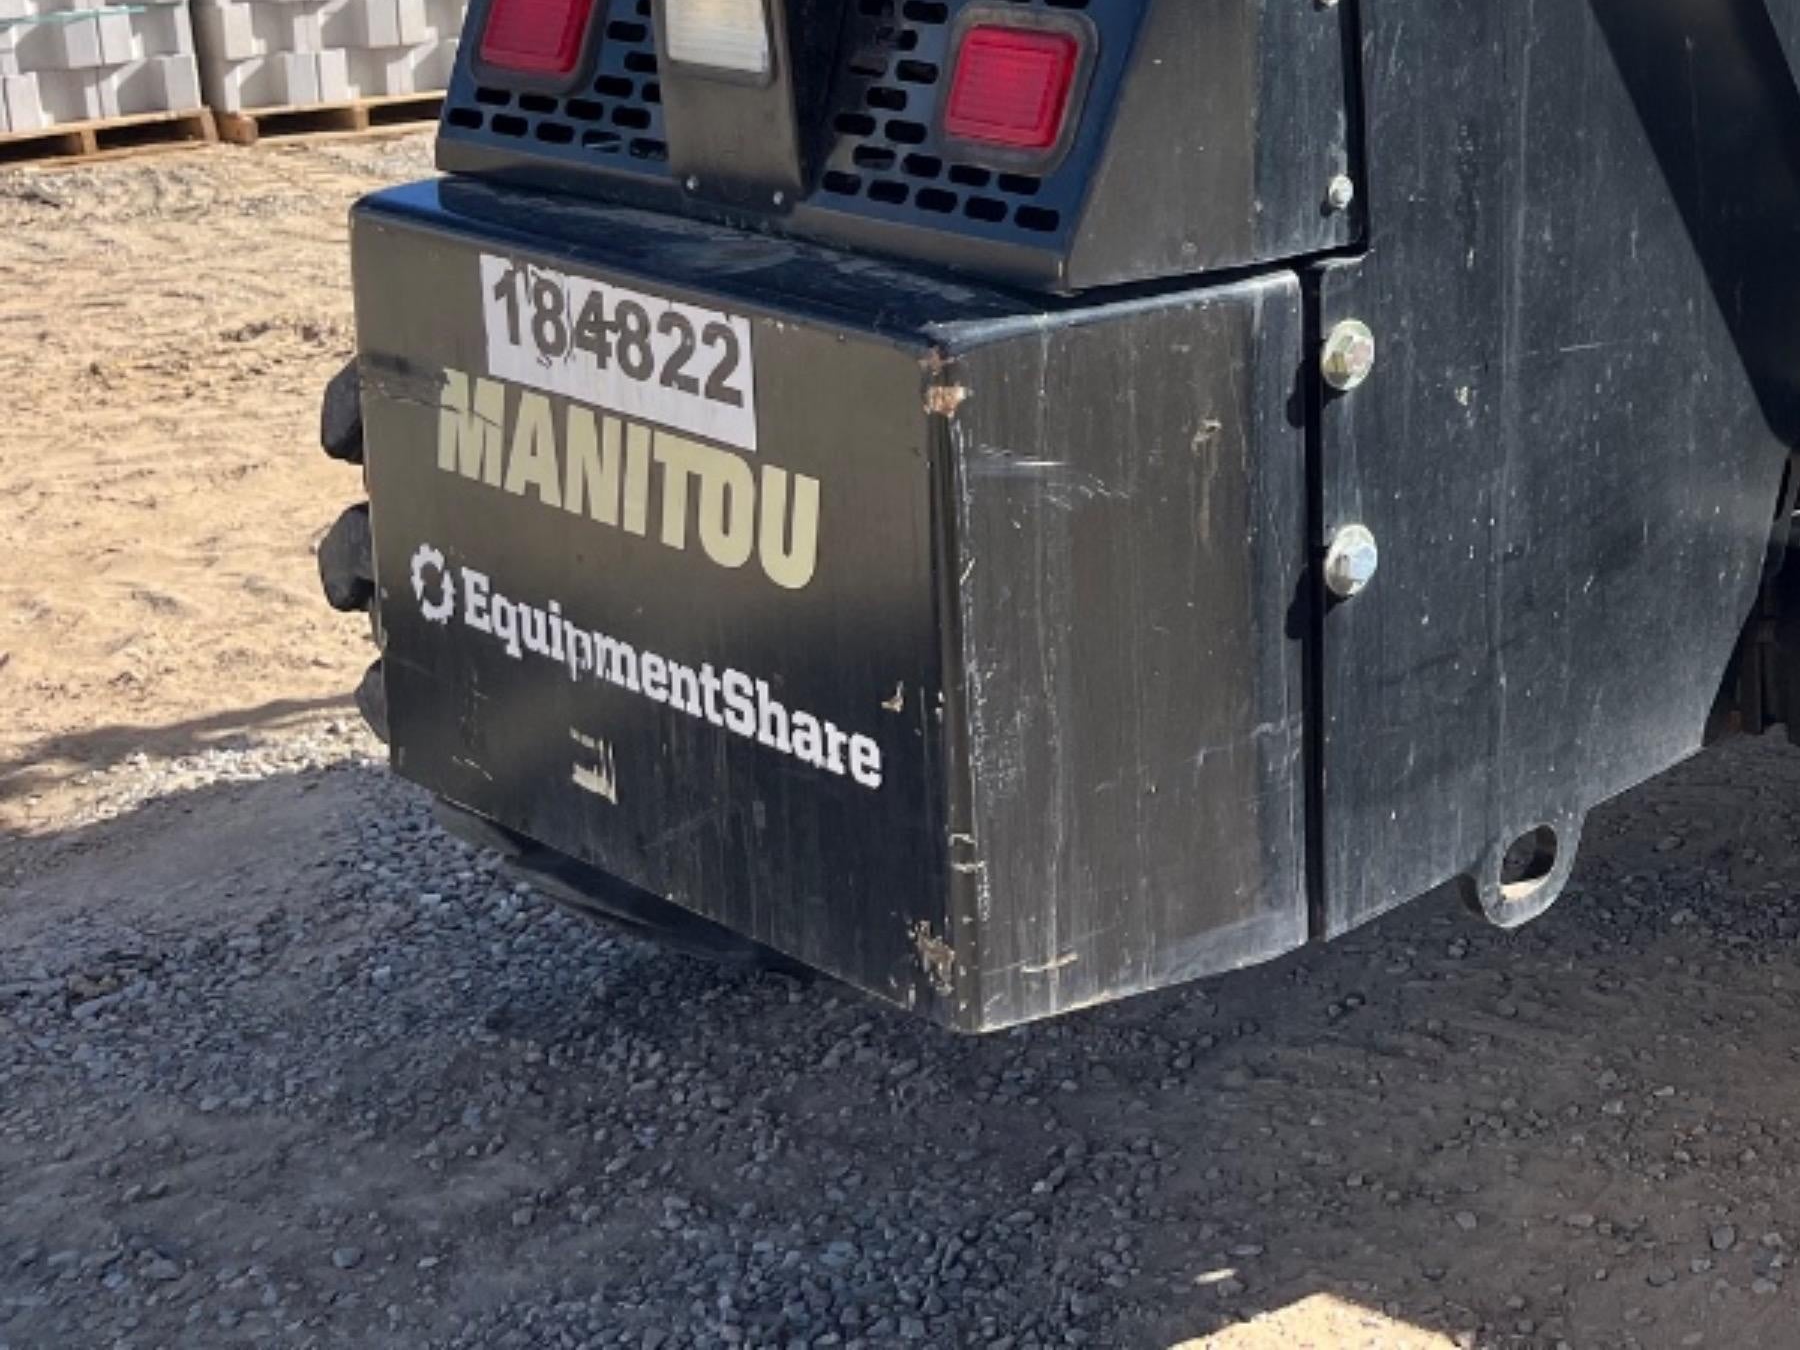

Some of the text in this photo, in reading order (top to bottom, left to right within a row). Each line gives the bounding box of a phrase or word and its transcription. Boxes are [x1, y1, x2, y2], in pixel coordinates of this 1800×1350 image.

[493, 262, 745, 408] 184822
[437, 368, 821, 590] MANITOU
[461, 566, 883, 790] EquipmentShare
